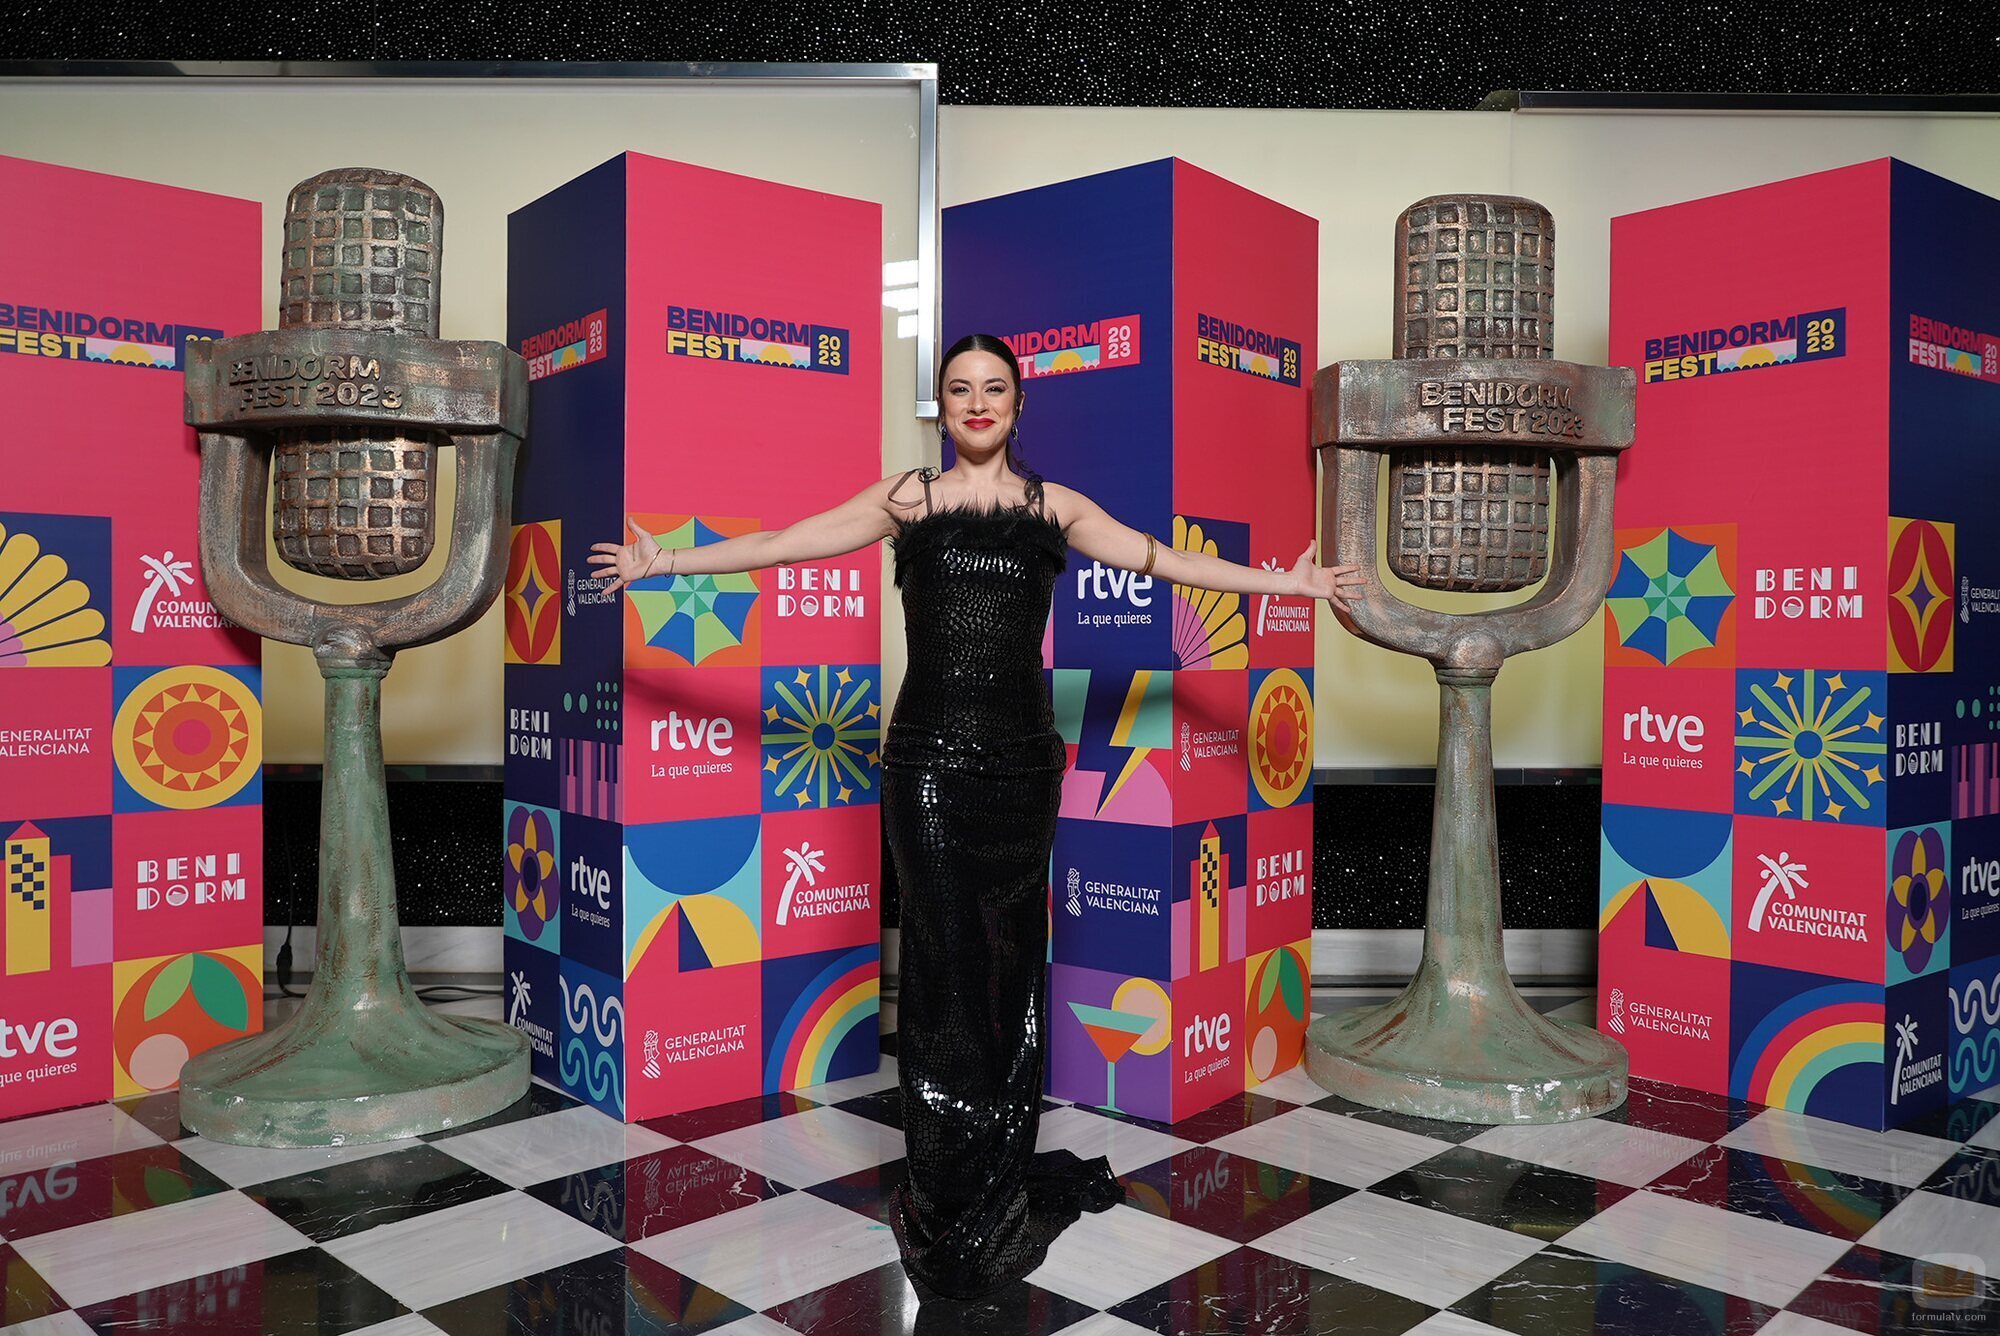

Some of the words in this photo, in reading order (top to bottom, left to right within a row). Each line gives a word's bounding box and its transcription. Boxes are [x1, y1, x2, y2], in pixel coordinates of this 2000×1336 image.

[590, 320, 602, 337] 20
[667, 305, 809, 346] BENIDORM
[1108, 325, 1131, 343] 20
[1198, 313, 1279, 358] BENIDORM
[1645, 316, 1796, 360] BENIDORM
[1807, 318, 1835, 338] 20
[1910, 313, 1981, 354] BENIDORM
[521, 317, 586, 360] BENIDORM
[590, 336, 602, 353] 23
[667, 330, 740, 361] FEST
[818, 334, 841, 350] 20
[998, 322, 1099, 356] NIDORM
[1108, 342, 1131, 359] 23
[1807, 334, 1835, 354] 23
[818, 350, 841, 366] 23
[1198, 337, 1240, 370] FEST
[1283, 347, 1297, 364] 20
[1909, 338, 1946, 370] FEST
[1985, 343, 1998, 360] 20
[230, 355, 381, 385] BENIDORM
[527, 353, 553, 381] EST
[1283, 362, 1297, 379] 23
[1644, 352, 1717, 384] FEST
[1985, 359, 1998, 375] 23
[240, 382, 307, 411] FEST
[316, 382, 402, 409] 2023
[1421, 382, 1571, 411] BENIDORM
[1443, 407, 1526, 433] FEST
[1531, 410, 1584, 439] 2023
[778, 568, 860, 591] BENI
[1078, 560, 1153, 607] rtve
[1756, 566, 1857, 592] BENI
[778, 595, 864, 617] DORM
[1971, 588, 2000, 600] GENERALI
[156, 601, 217, 614] COMUN
[1078, 612, 1090, 625] La
[1092, 614, 1112, 628] que
[1114, 611, 1152, 628] quieres
[1268, 605, 1310, 619] COMUNITAT
[1755, 595, 1863, 619] DORM
[1971, 602, 2000, 613] VALENCIA
[152, 615, 240, 628] VALENCIA
[1266, 619, 1310, 632] VALENCIANA
[511, 709, 549, 733] BENI
[651, 711, 733, 756] rtve
[1623, 706, 1704, 752] rtve
[0, 728, 92, 742] ENERALITAT
[510, 734, 551, 760] DORM
[1193, 730, 1239, 744] GENERALITAT
[1896, 722, 1941, 748] BENI
[0, 743, 90, 757] ALENCIANA
[1193, 744, 1238, 758] VALENCIANA
[1623, 752, 1636, 764] La
[1639, 756, 1660, 768] que
[1662, 756, 1703, 769] quieres
[651, 764, 665, 777] La
[668, 765, 690, 779] que
[692, 761, 733, 777] quieres
[1895, 750, 1943, 777] DORM
[137, 853, 240, 883] BENI
[1257, 850, 1303, 880] BENI
[1962, 856, 2000, 897] rtve
[137, 878, 246, 911] DORM
[571, 855, 611, 910] rtve
[796, 883, 870, 904] COMUNITAT
[1085, 881, 1161, 901] GENERALITAT
[1256, 874, 1305, 907] DORM
[571, 903, 579, 917] La
[579, 909, 590, 922] que
[590, 911, 611, 928] quieres
[793, 897, 871, 919] VALENCIANA
[1086, 895, 1159, 916] VALENCIANA
[1772, 902, 1867, 927] COMUNITAT
[1962, 907, 1969, 919] La
[1970, 907, 1980, 921] que
[1980, 902, 2000, 918] quieres
[1768, 916, 1868, 942] VALENCIANA
[1629, 1002, 1713, 1027] GENERALITAT
[0, 1017, 78, 1058] tve
[516, 1016, 553, 1044] COMUNITAT
[665, 1025, 746, 1050] GENERALITAT
[1184, 1013, 1231, 1058] rtve
[1630, 1015, 1711, 1040] VALENCIANA
[530, 1036, 554, 1058] NCIANA
[666, 1039, 745, 1064] VALENCIANA
[26, 1062, 77, 1083] quieres
[1184, 1070, 1194, 1084] La
[1194, 1065, 1207, 1082] que
[1207, 1055, 1230, 1077] quieres
[1901, 1053, 1942, 1081] COMUNITAT
[1900, 1068, 1942, 1096] VALENCIANA
